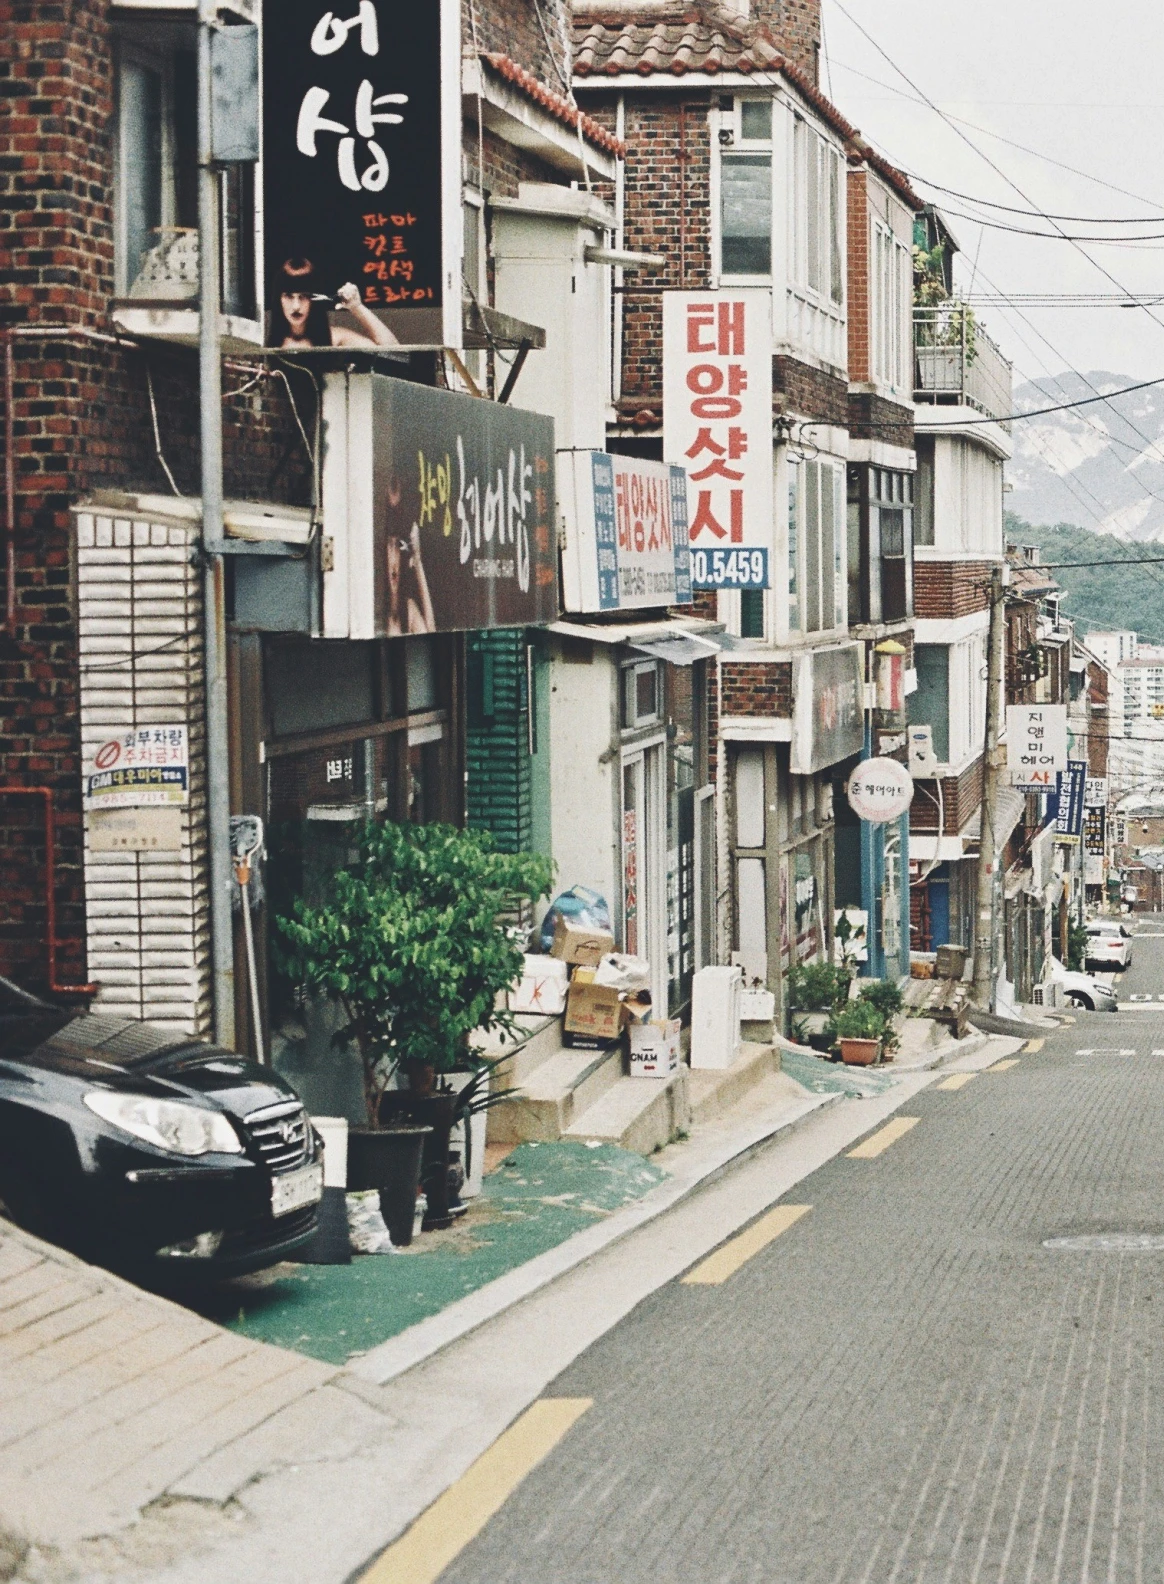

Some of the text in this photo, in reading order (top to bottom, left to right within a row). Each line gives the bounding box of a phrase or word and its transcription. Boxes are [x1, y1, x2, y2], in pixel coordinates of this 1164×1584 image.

[362, 212, 417, 228] 파마
[363, 259, 414, 281] 염색
[364, 286, 434, 303] 드라이
[685, 302, 748, 543] 태양샷시
[615, 472, 672, 553] 태양샷시
[124, 729, 182, 748] 외부차량
[124, 747, 183, 764] 주차금지
[1020, 755, 1055, 766] 헤어
